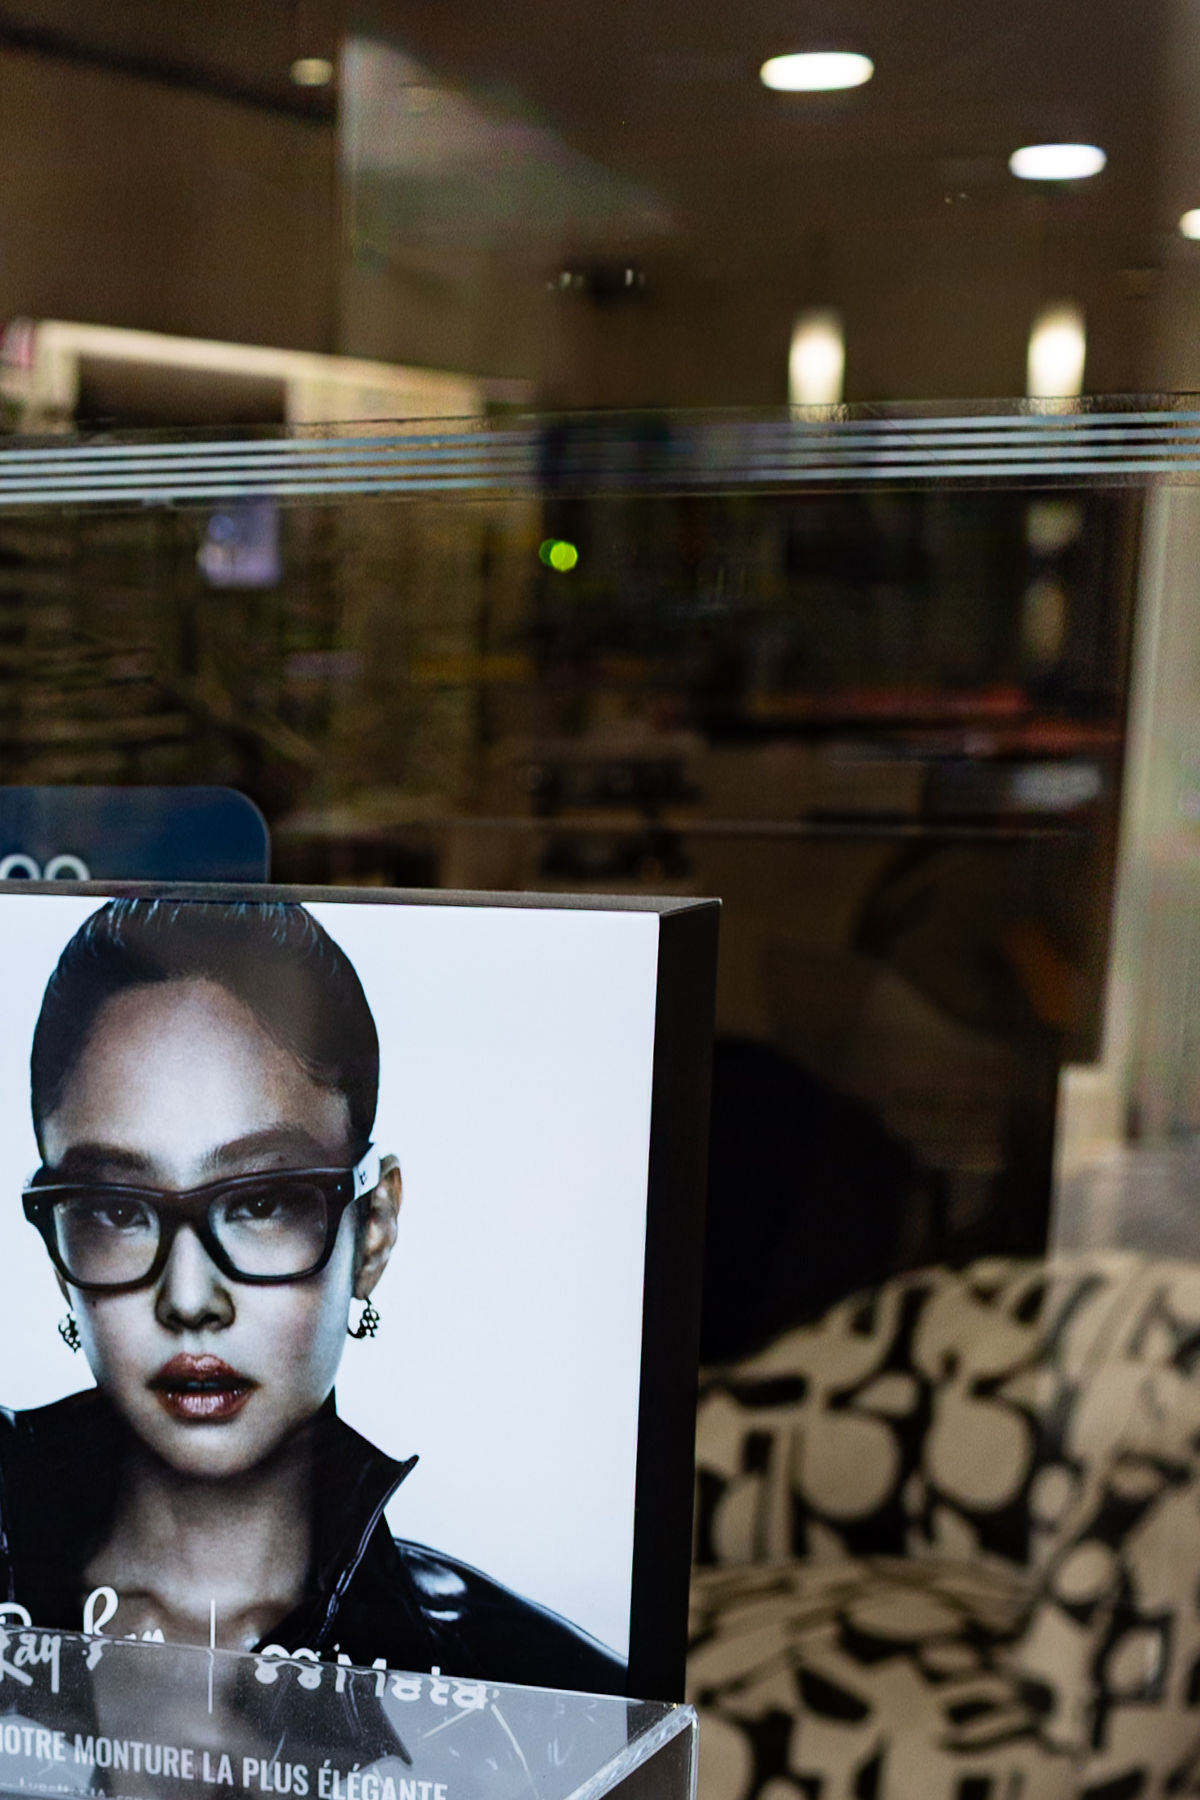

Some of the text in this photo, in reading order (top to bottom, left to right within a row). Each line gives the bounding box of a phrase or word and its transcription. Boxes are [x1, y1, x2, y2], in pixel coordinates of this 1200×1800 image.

[74, 1733, 195, 1780] MONTURE
[202, 1751, 234, 1786] LA
[242, 1756, 310, 1797] PLUS
